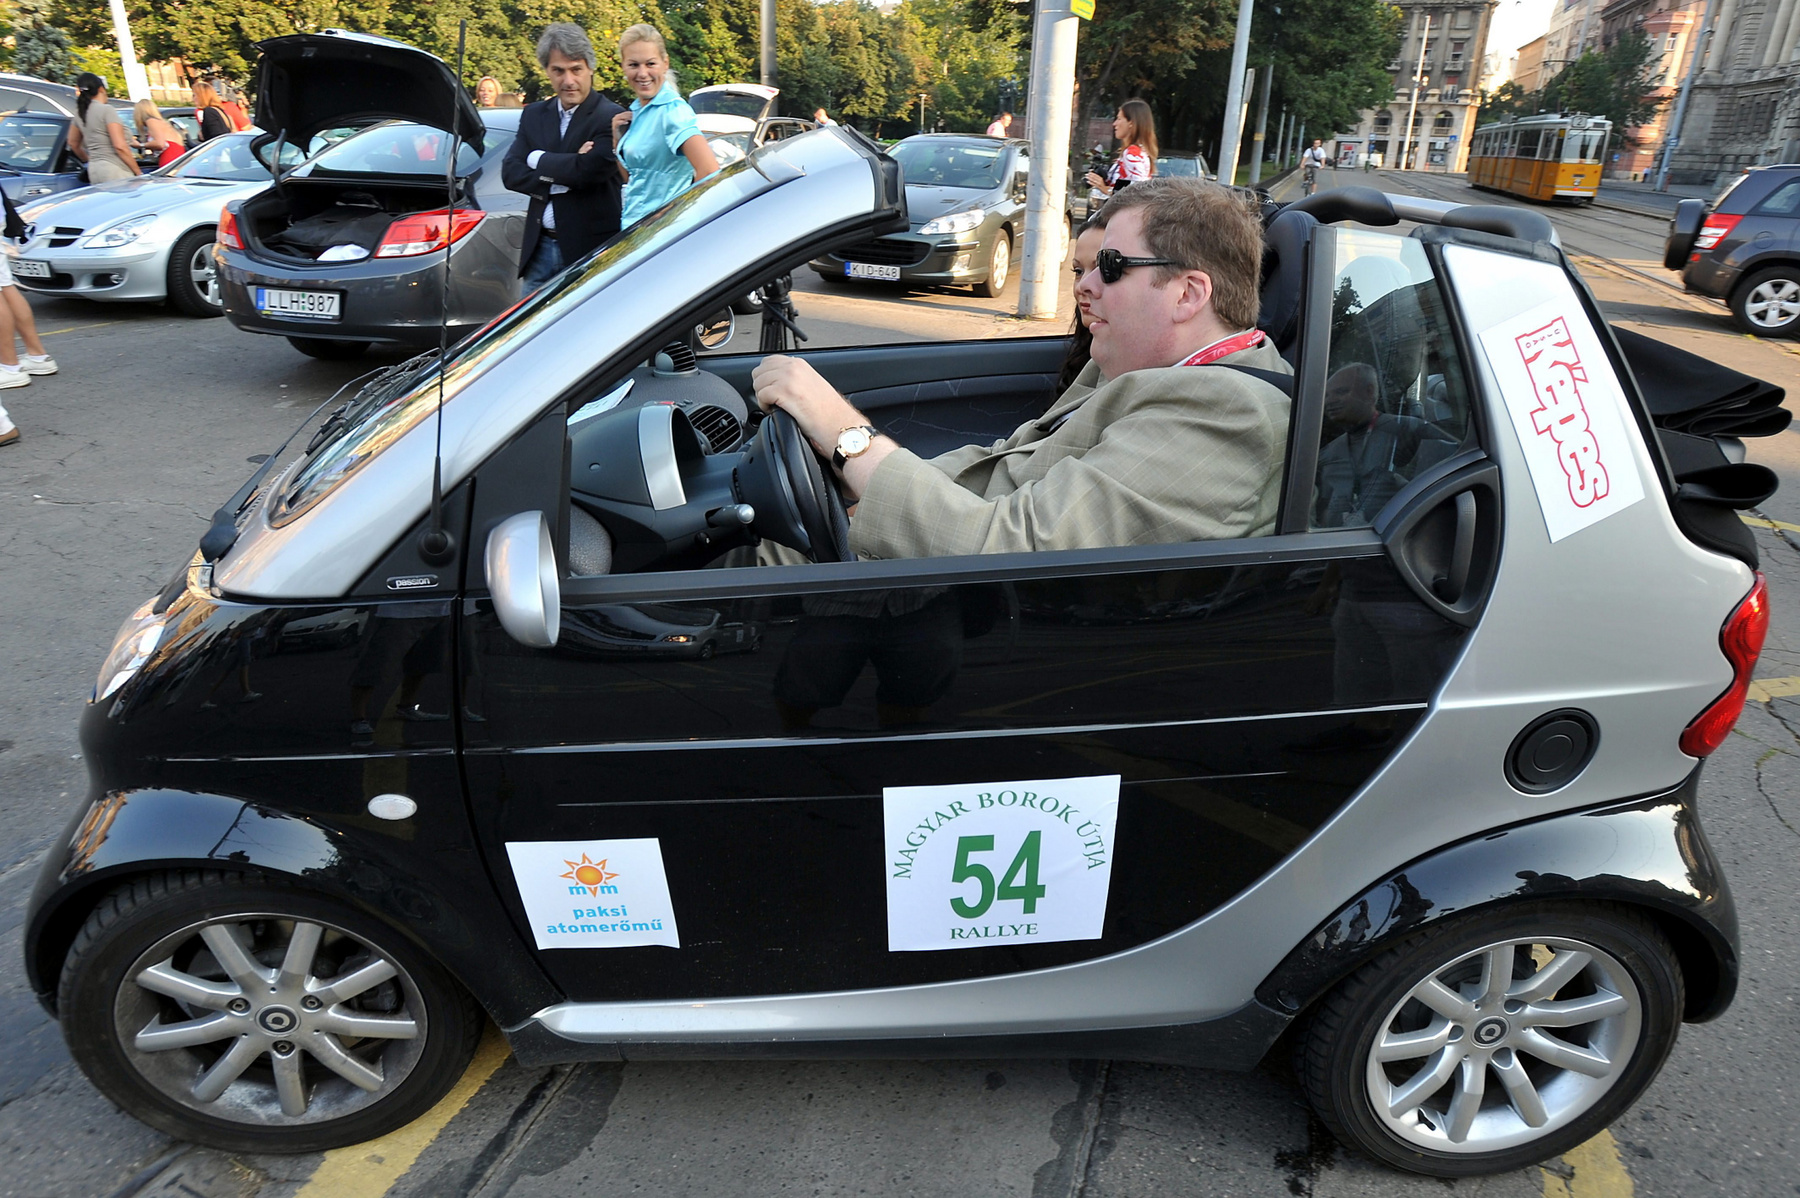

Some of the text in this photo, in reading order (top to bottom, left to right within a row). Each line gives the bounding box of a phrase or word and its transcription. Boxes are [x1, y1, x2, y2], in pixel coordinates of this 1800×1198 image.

[852, 264, 898, 278] KID-648
[268, 291, 335, 313] LLH-987
[395, 577, 431, 589] passion
[893, 790, 1106, 880] MAGYAR BOROK ÚTJA
[949, 830, 1046, 919] 54
[573, 904, 628, 920] paksi
[547, 918, 663, 934] atomerőmű
[950, 922, 1039, 940] RALLYE
